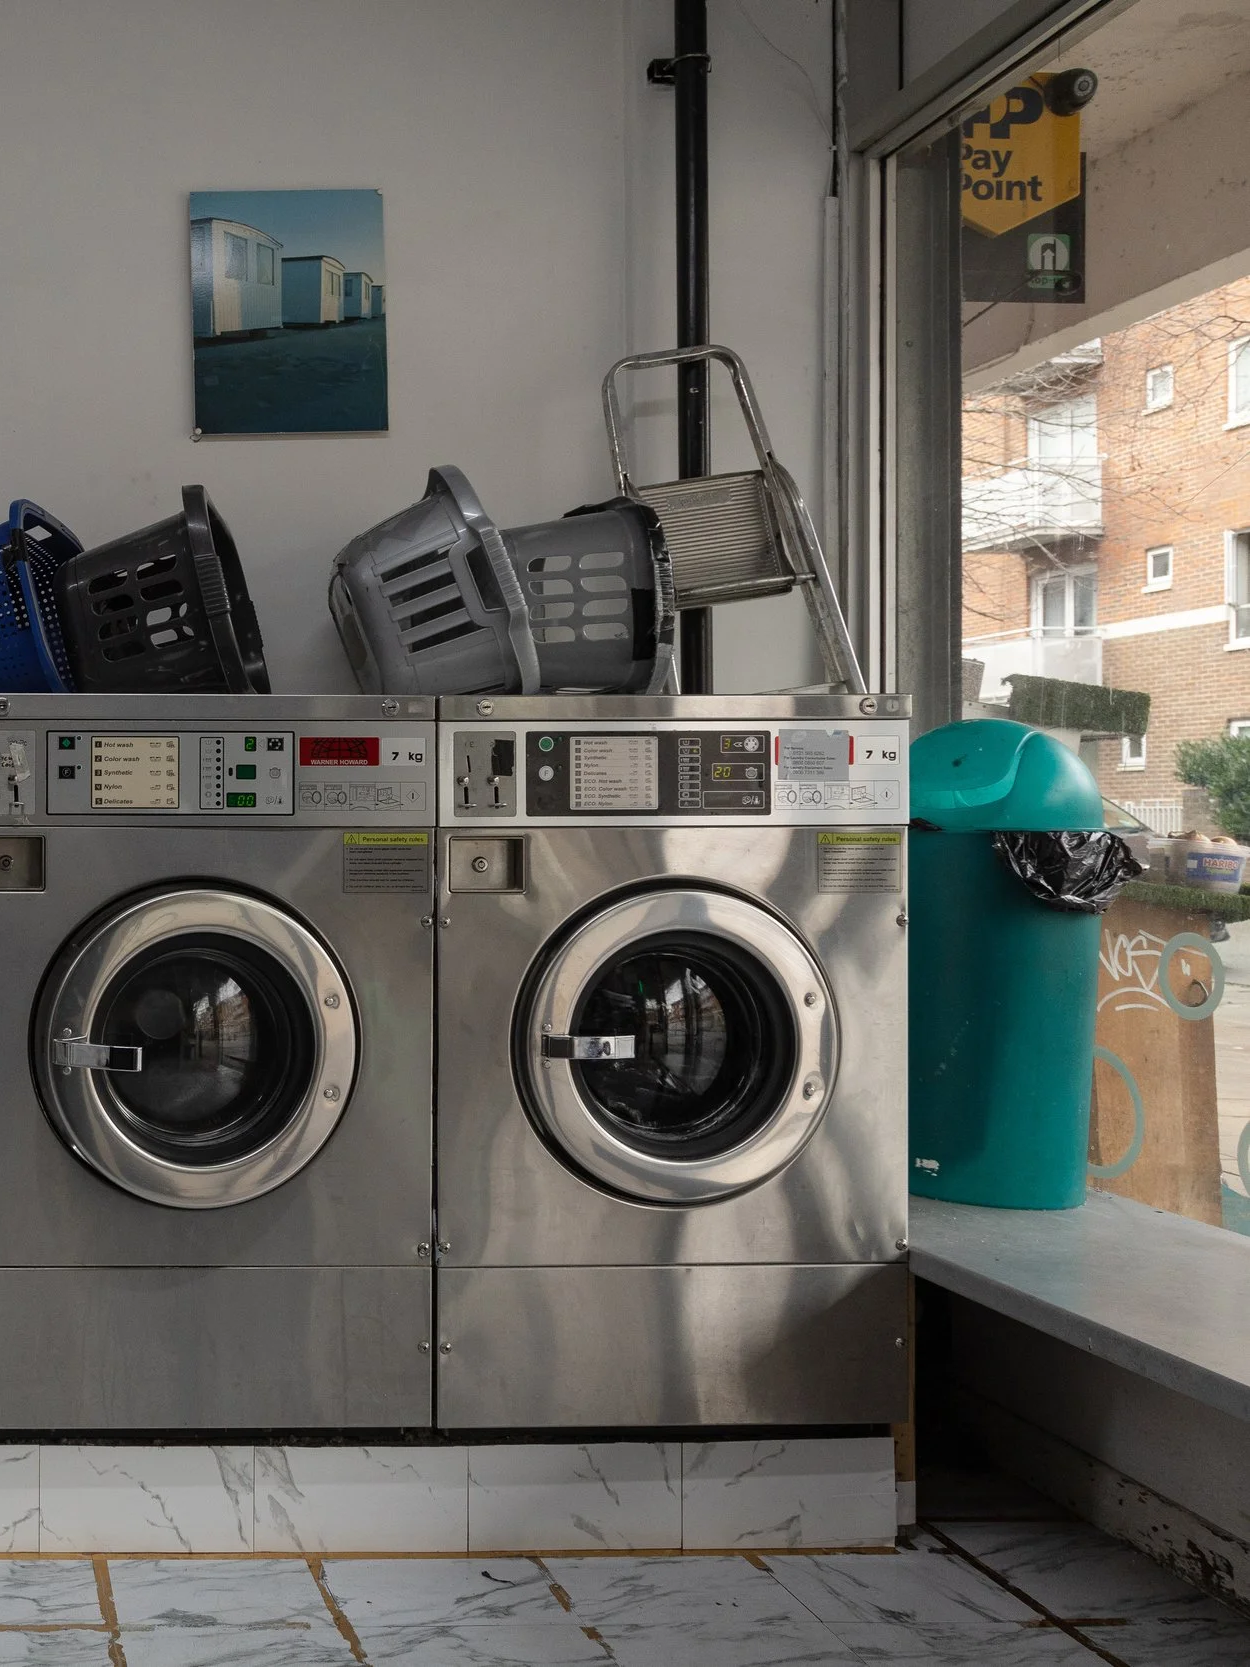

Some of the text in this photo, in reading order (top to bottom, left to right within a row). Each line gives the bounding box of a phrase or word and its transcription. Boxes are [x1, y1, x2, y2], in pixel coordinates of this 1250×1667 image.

[246, 738, 254, 750] 2
[723, 738, 731, 749] 3
[392, 751, 424, 762] 7 kg
[865, 750, 897, 761] 7 kg
[714, 766, 731, 778] 20
